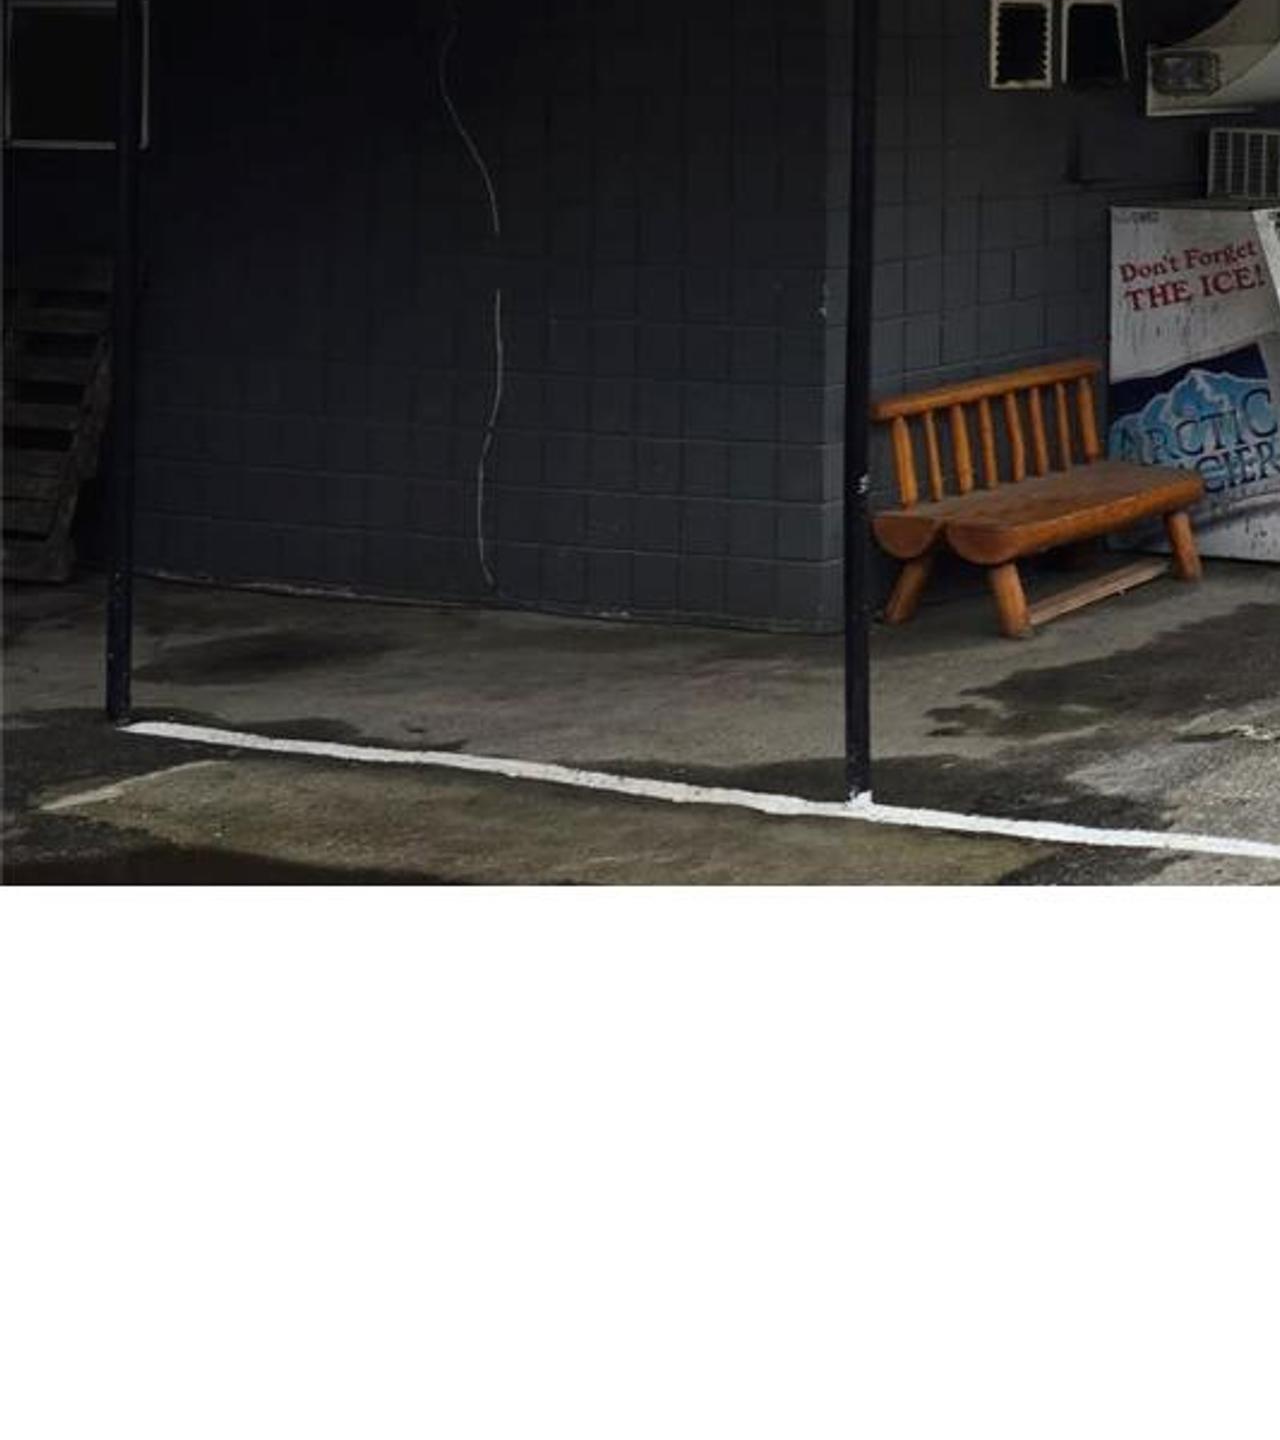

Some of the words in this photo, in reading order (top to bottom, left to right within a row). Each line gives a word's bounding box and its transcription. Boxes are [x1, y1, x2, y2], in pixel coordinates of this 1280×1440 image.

[1119, 253, 1180, 283] Don't
[1183, 236, 1258, 271] Forget
[1125, 279, 1194, 312] THE
[1200, 262, 1267, 298] ICE!
[1113, 388, 1279, 468] ARCTIC
